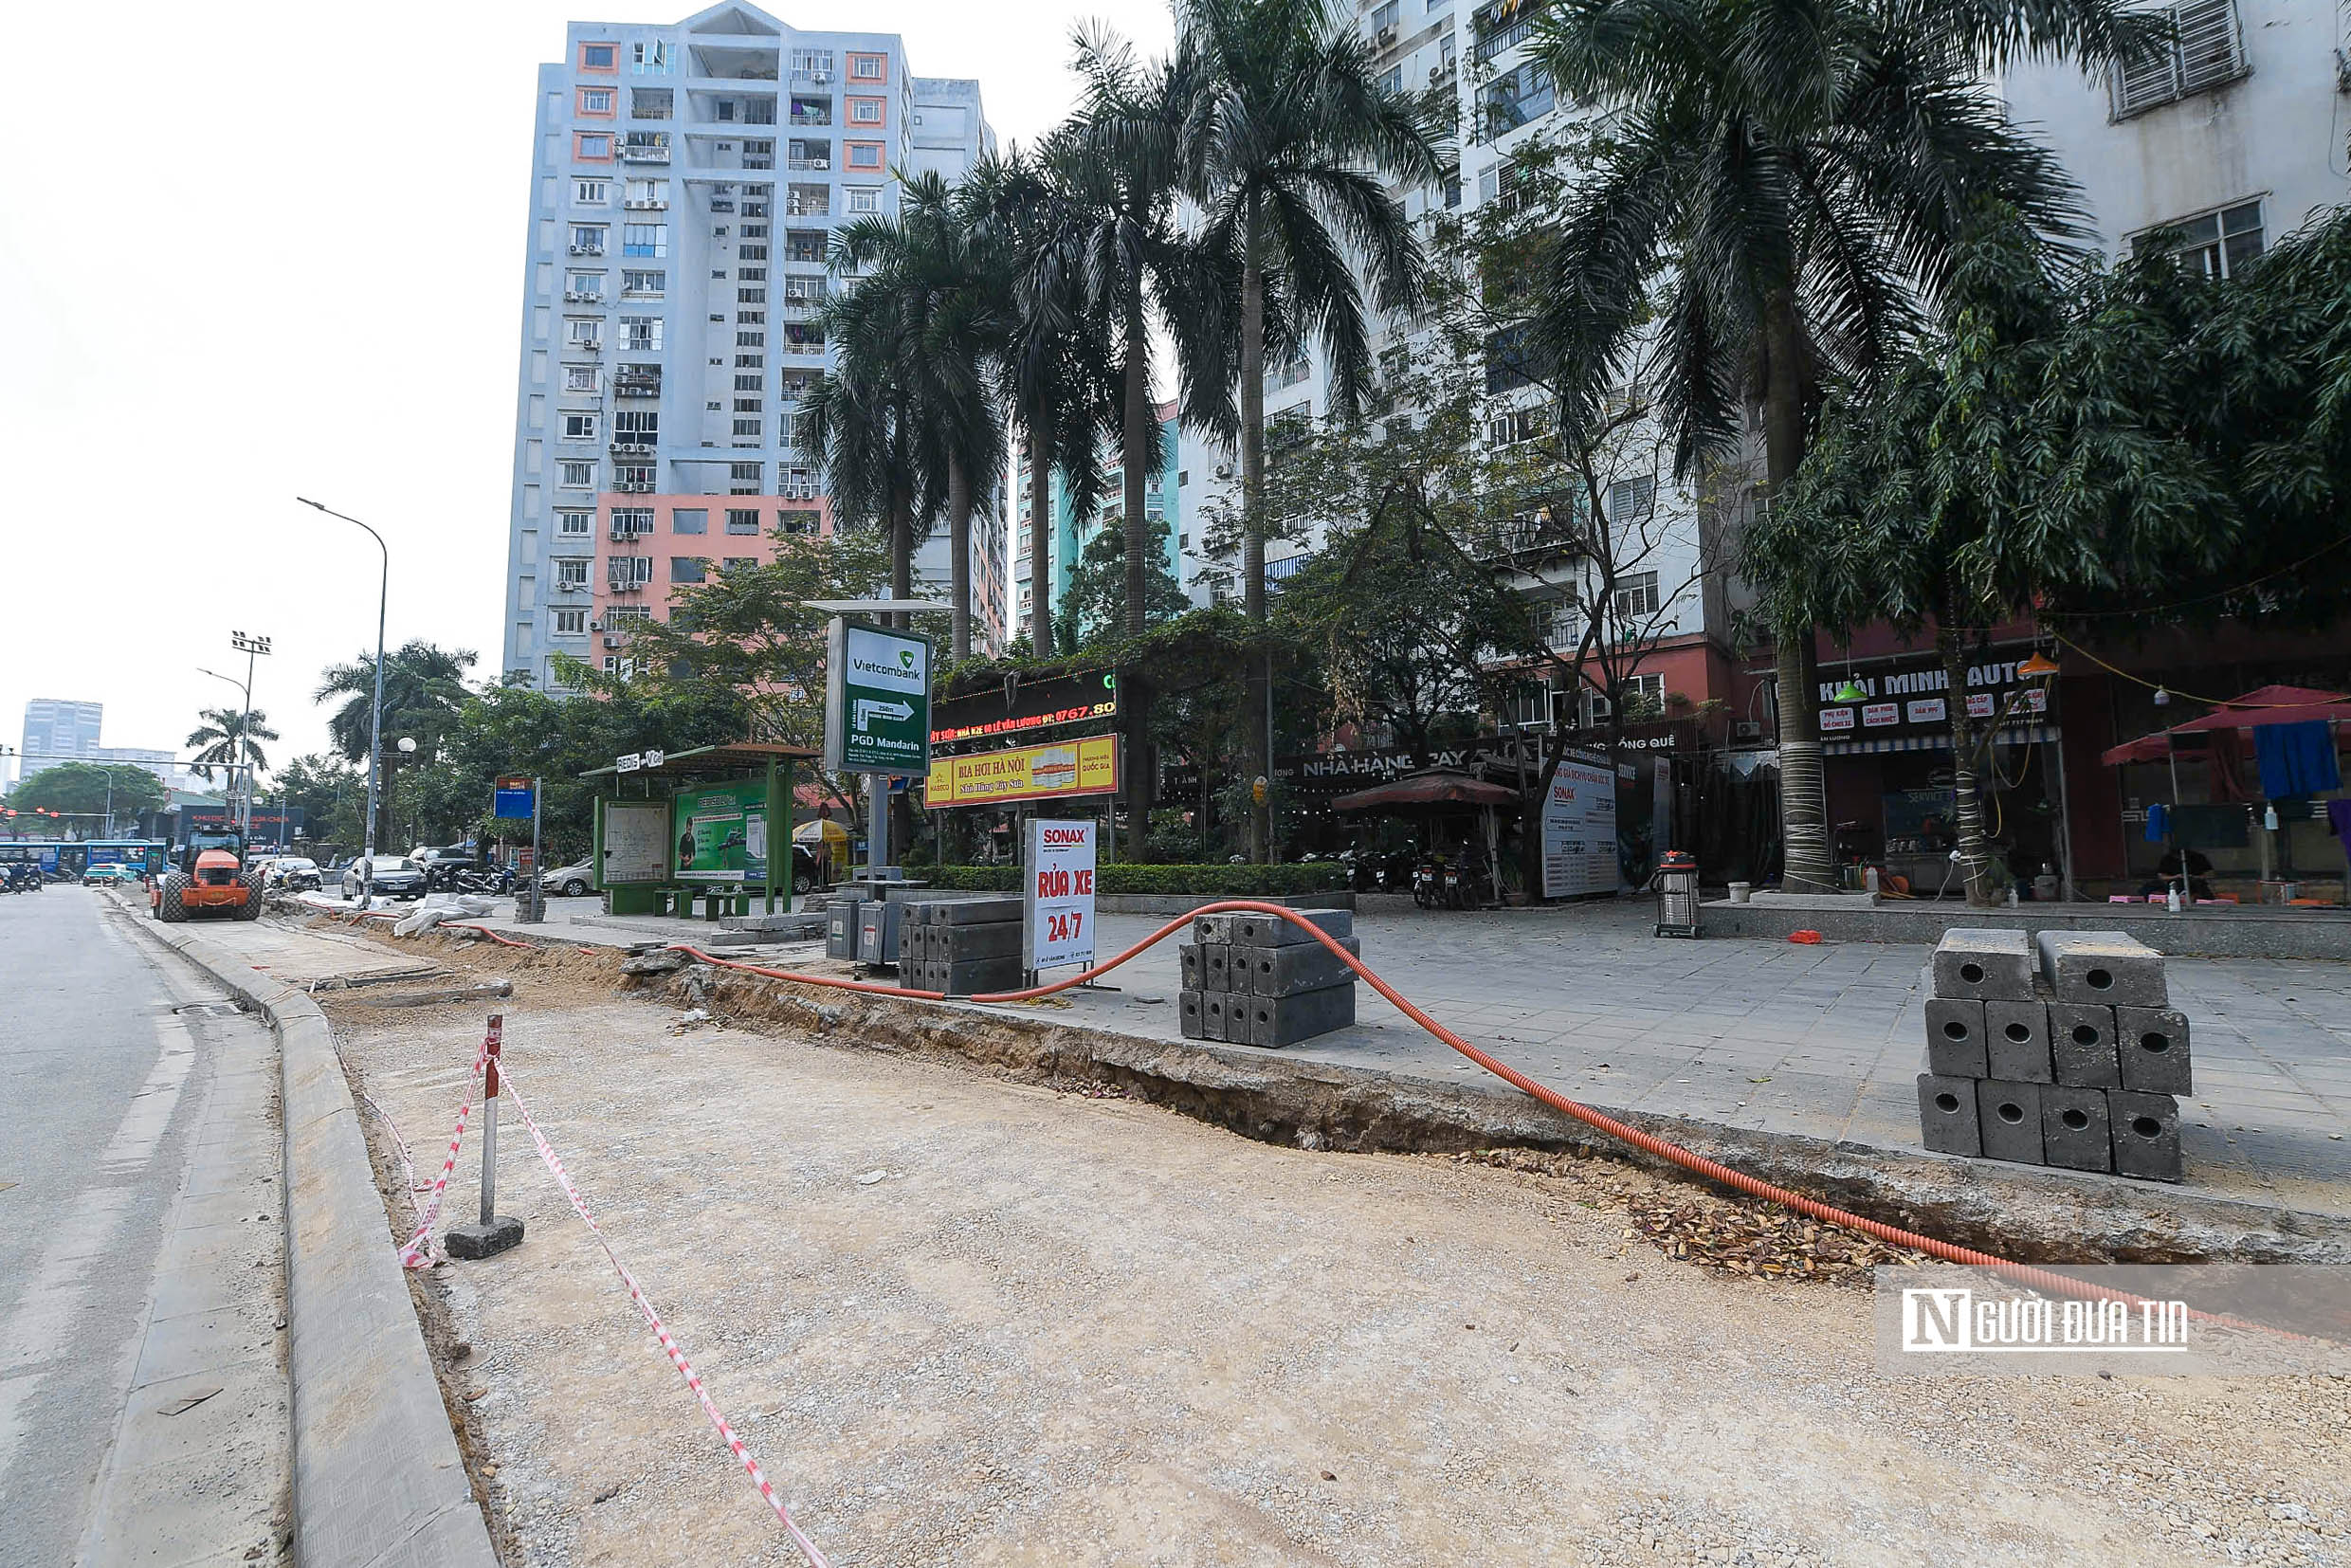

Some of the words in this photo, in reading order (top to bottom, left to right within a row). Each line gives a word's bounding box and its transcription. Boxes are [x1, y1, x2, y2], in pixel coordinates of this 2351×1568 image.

[853, 658, 920, 681] Vietcombank
[1885, 669, 1949, 695] MINH
[851, 734, 874, 746] PGD
[877, 737, 920, 751] Mandarin
[1649, 734, 1675, 748] QUÊ
[958, 765, 973, 777] BIA
[975, 762, 992, 776] HƠI
[993, 757, 1006, 775] HÀ
[1008, 756, 1025, 775] NỘI
[1303, 755, 1350, 776] NHÀ
[1554, 786, 1575, 800] SONAX
[1043, 830, 1085, 843] SONAX
[1038, 863, 1069, 898] RỬA
[1073, 869, 1093, 896] XE
[1048, 911, 1083, 942] 24/7
